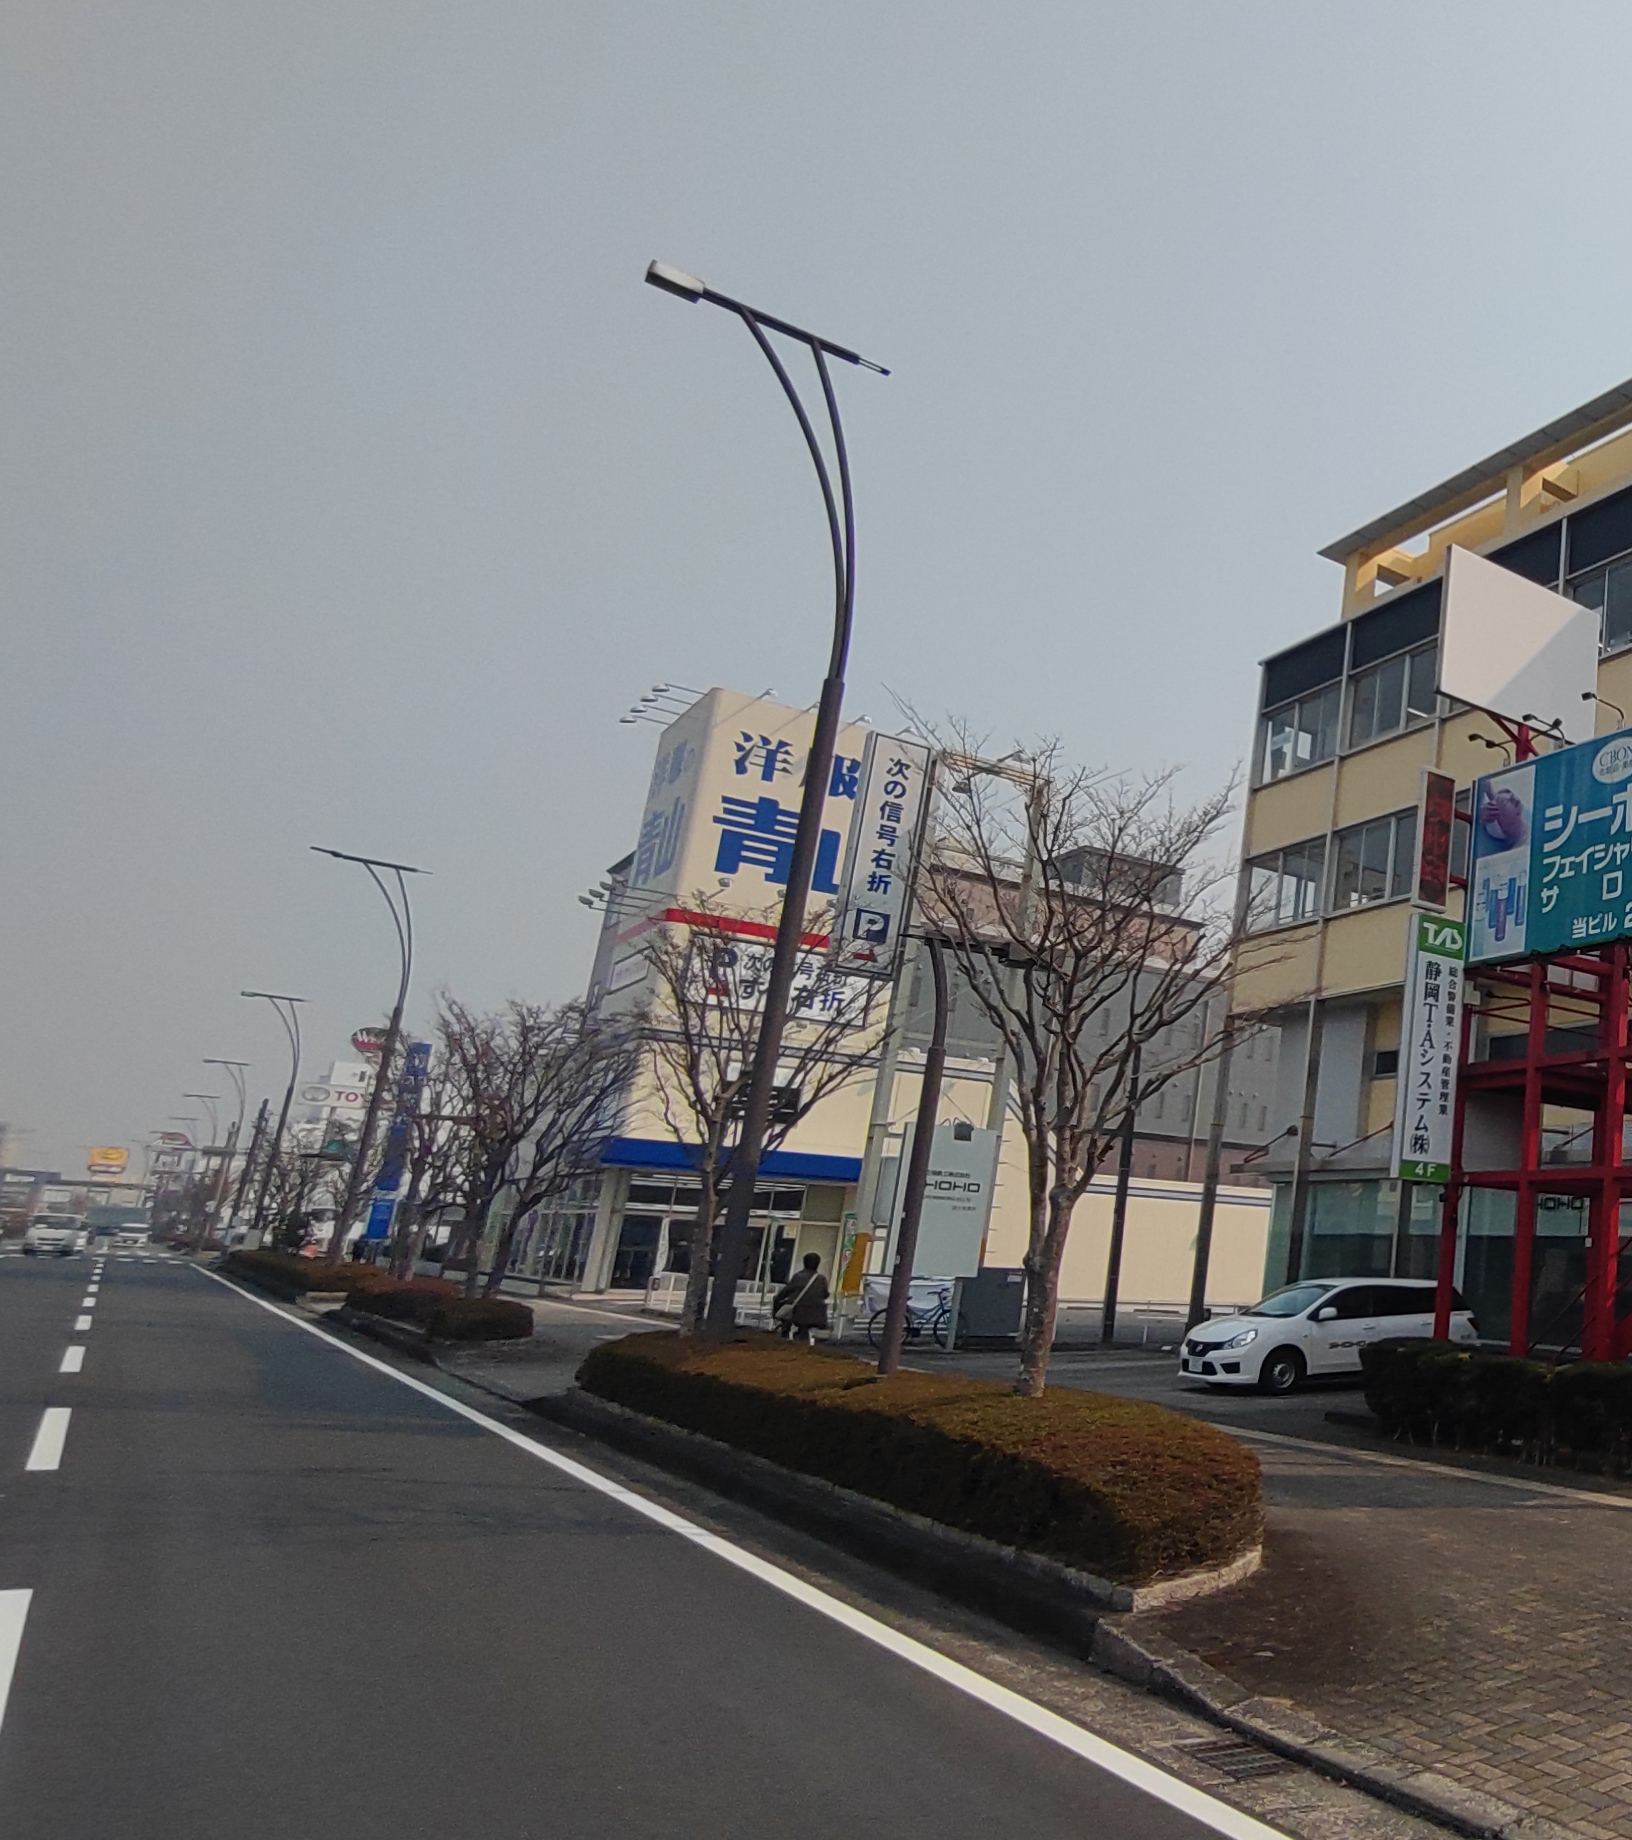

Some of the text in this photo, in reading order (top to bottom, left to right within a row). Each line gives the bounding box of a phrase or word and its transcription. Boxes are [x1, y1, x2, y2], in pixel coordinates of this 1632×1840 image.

[866, 758, 912, 895] 次の信号右折
[1423, 922, 1463, 951] TAS
[1572, 911, 1618, 939] 当ビル
[1414, 1162, 1437, 1177] 4F
[926, 1180, 981, 1193] HOHO
